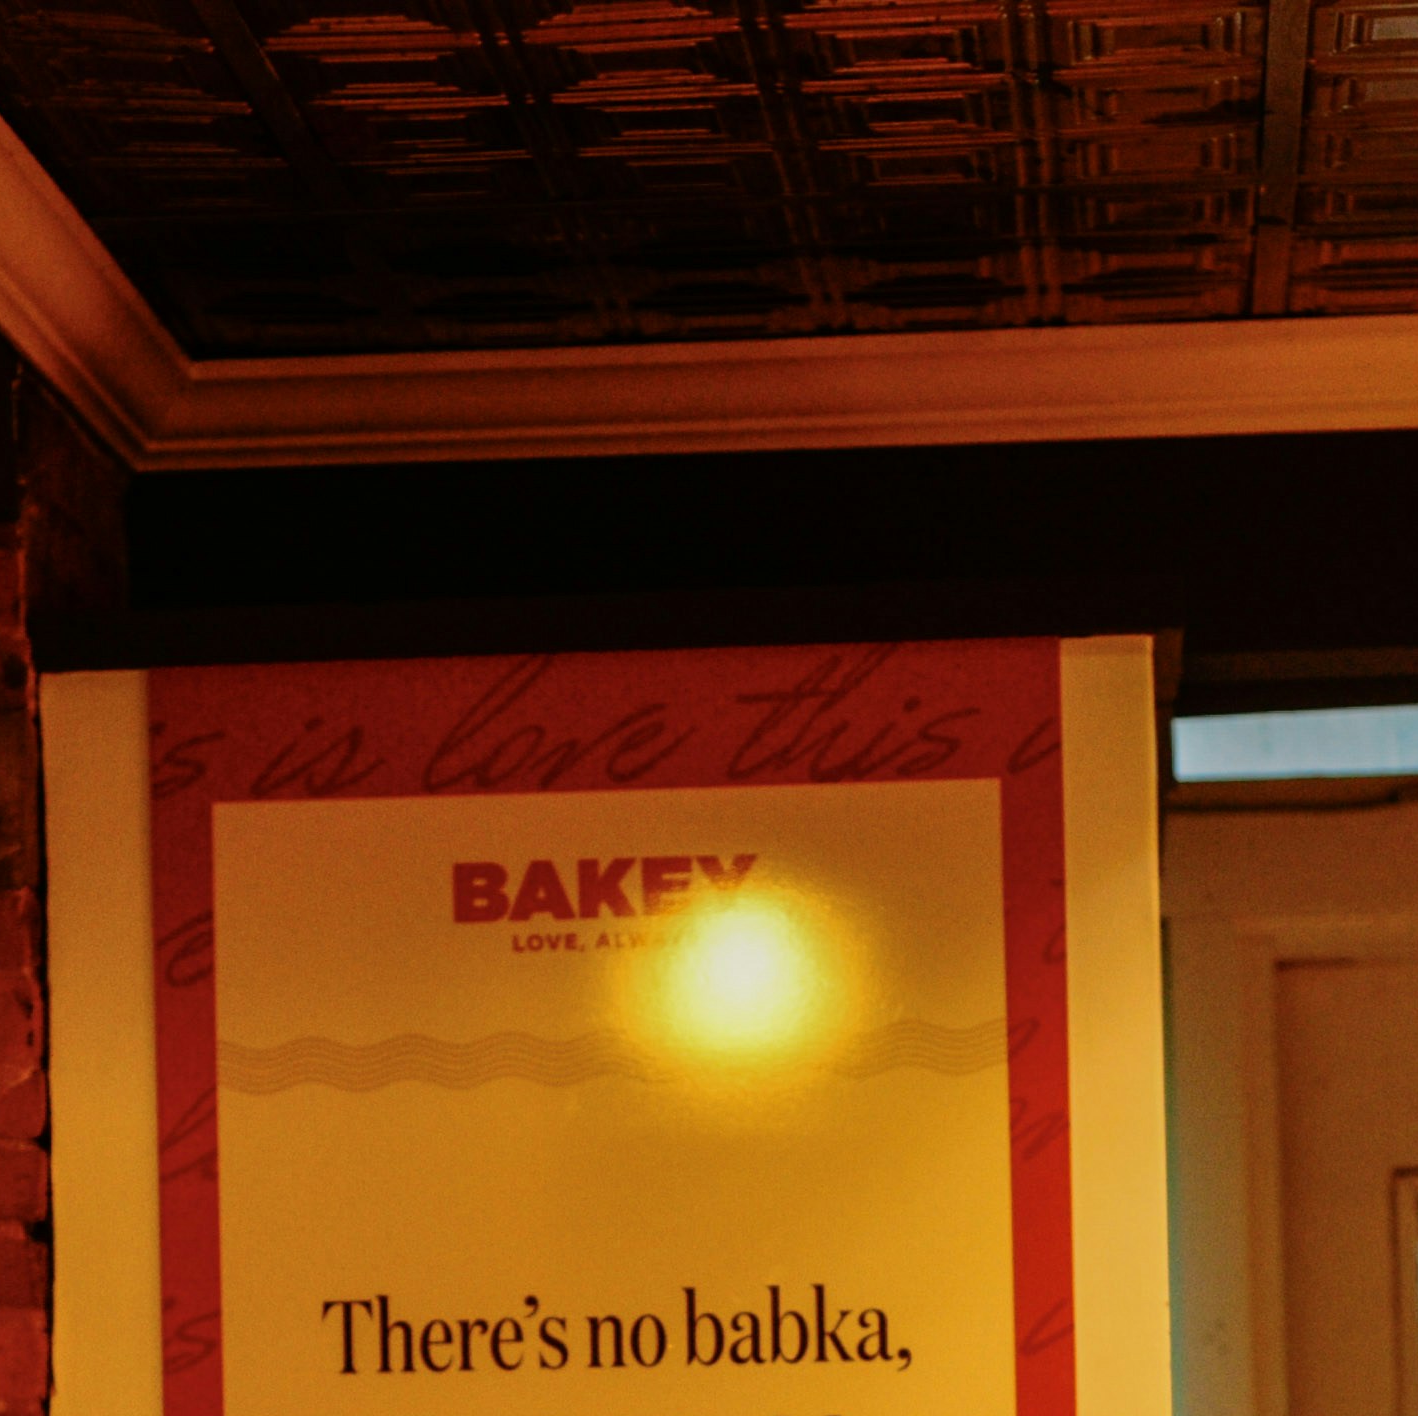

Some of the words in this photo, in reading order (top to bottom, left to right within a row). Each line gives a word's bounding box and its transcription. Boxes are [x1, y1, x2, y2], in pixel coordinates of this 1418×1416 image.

[728, 644, 981, 784] this
[511, 932, 586, 953] LOVE,
[322, 1294, 569, 1375] There’s
[587, 1314, 667, 1369] no
[683, 1283, 914, 1371] babka,
